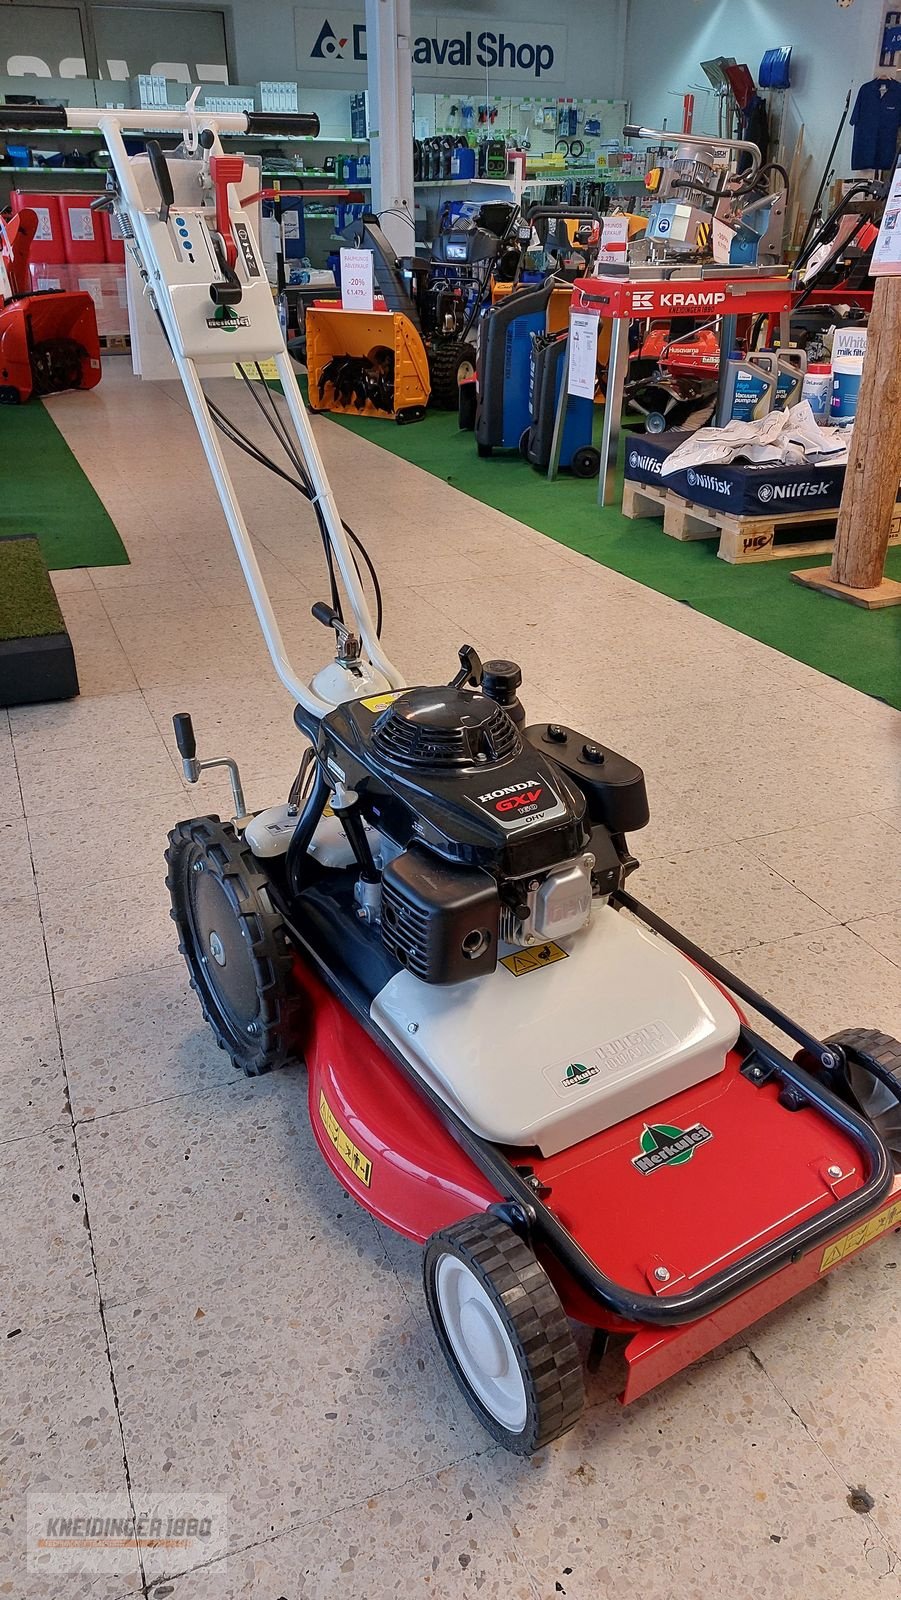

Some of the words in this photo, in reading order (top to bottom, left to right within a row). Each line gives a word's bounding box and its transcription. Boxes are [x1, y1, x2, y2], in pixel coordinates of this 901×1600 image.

[353, 24, 471, 66] Daval
[476, 32, 554, 77] Shop
[348, 278, 365, 286] -20%
[660, 293, 725, 305] KRAMP
[838, 348, 852, 356] milk
[736, 382, 749, 391] High
[638, 455, 662, 474] Nilfis
[697, 473, 731, 496] Nilfisk
[773, 482, 829, 499] Nilfisk
[477, 780, 541, 803] HONDA
[495, 789, 542, 812] GXV
[517, 803, 538, 814] 160
[525, 812, 545, 823] OHV
[563, 1066, 600, 1087] Herkules
[636, 1126, 710, 1172] Herkules
